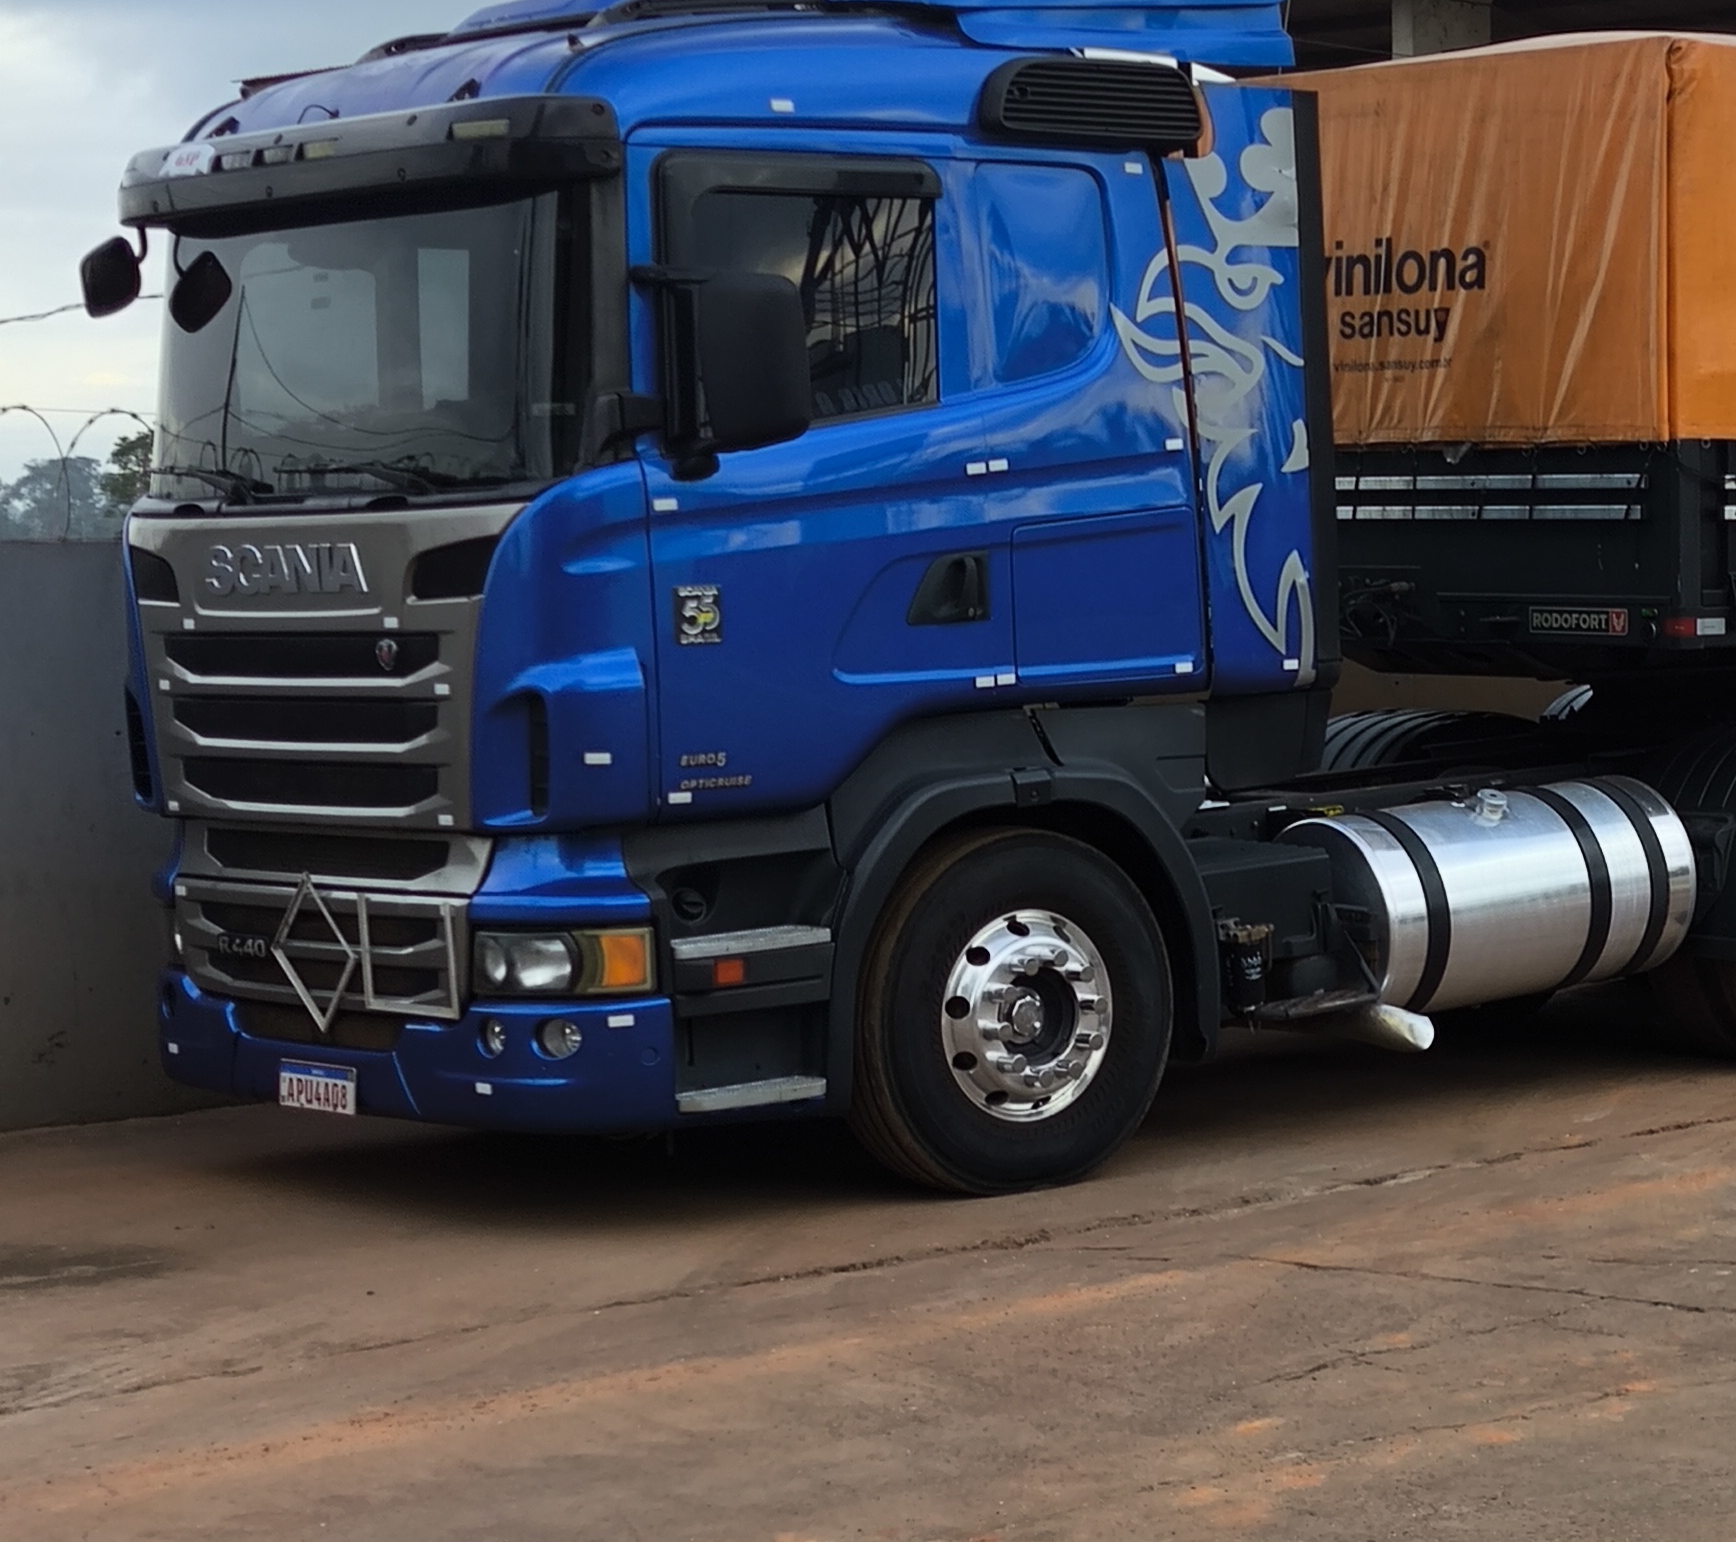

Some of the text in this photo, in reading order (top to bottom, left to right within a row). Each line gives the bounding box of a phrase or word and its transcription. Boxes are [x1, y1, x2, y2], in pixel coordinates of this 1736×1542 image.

[1339, 307, 1450, 343] sansuy
[205, 542, 369, 596] SCANIA
[681, 596, 720, 635] 55
[1532, 612, 1607, 630] RODOFORT
[680, 775, 753, 790] OPTICRUISE
[218, 935, 266, 958] R440
